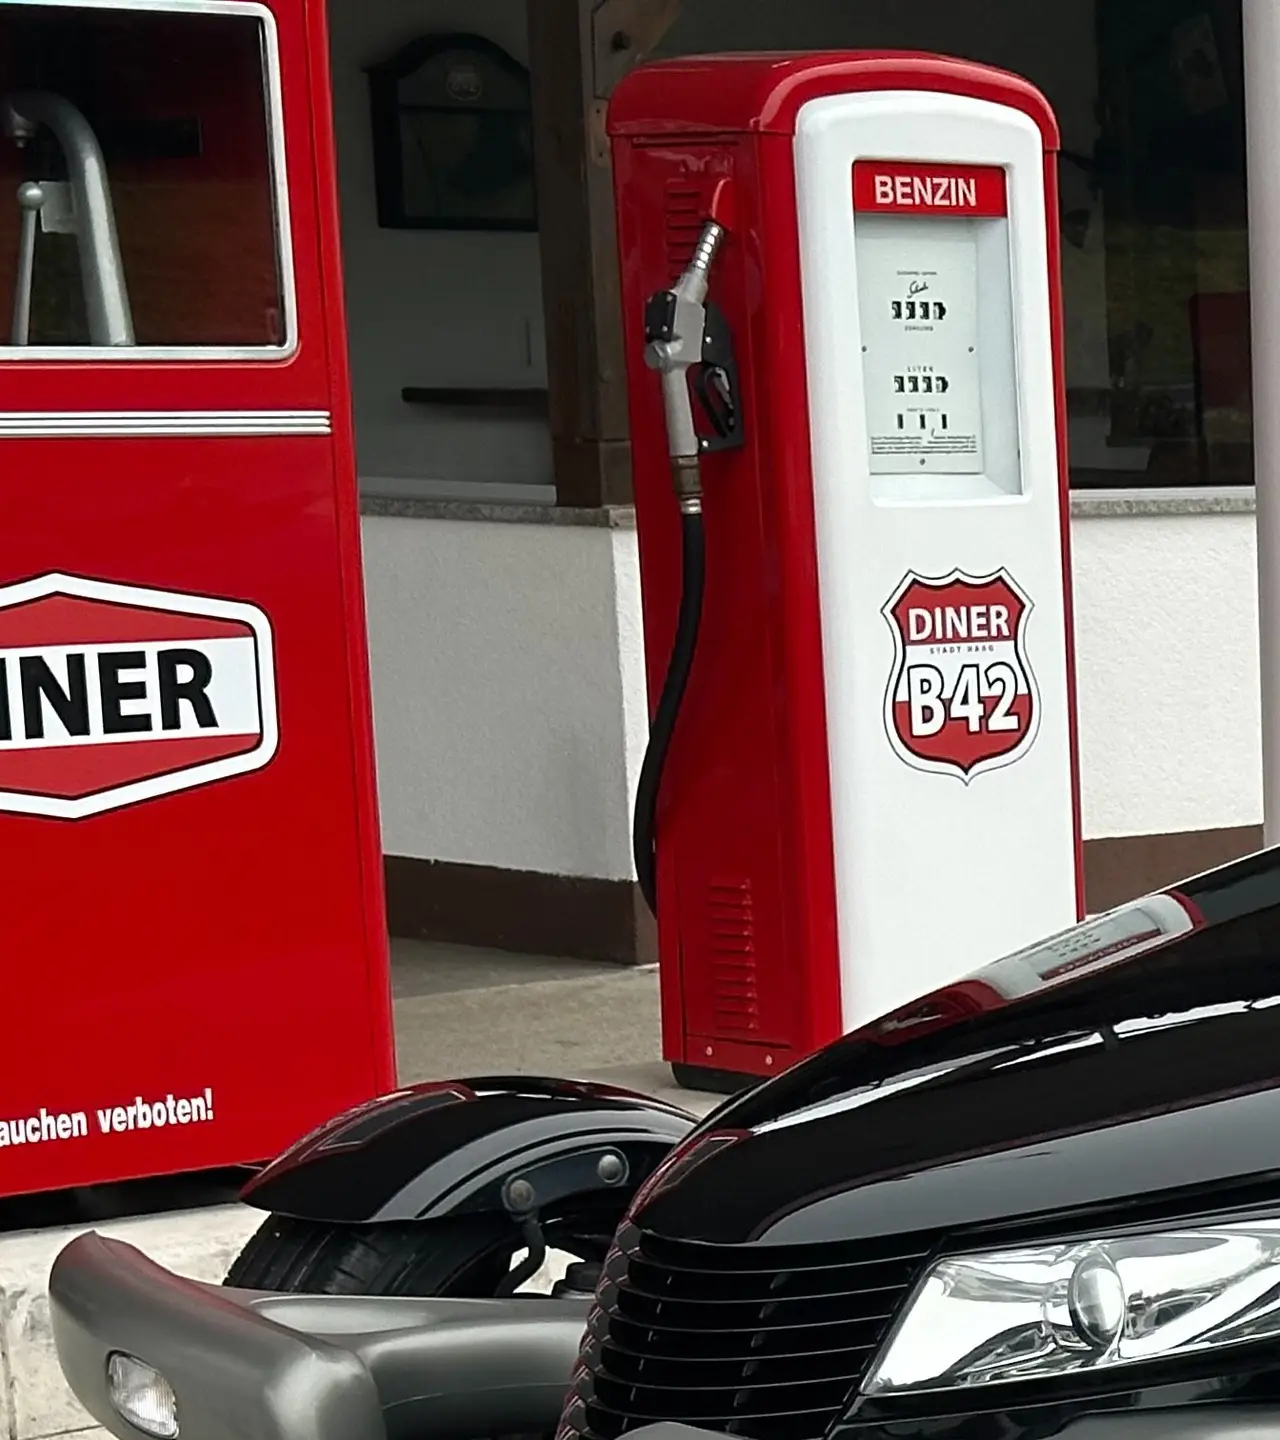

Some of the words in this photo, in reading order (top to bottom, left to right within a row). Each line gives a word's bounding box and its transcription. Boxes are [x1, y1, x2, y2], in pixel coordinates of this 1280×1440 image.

[874, 175, 977, 207] BENZIN
[908, 604, 1011, 641] DINER
[907, 661, 1021, 739] B42
[97, 1087, 214, 1133] verboten!
